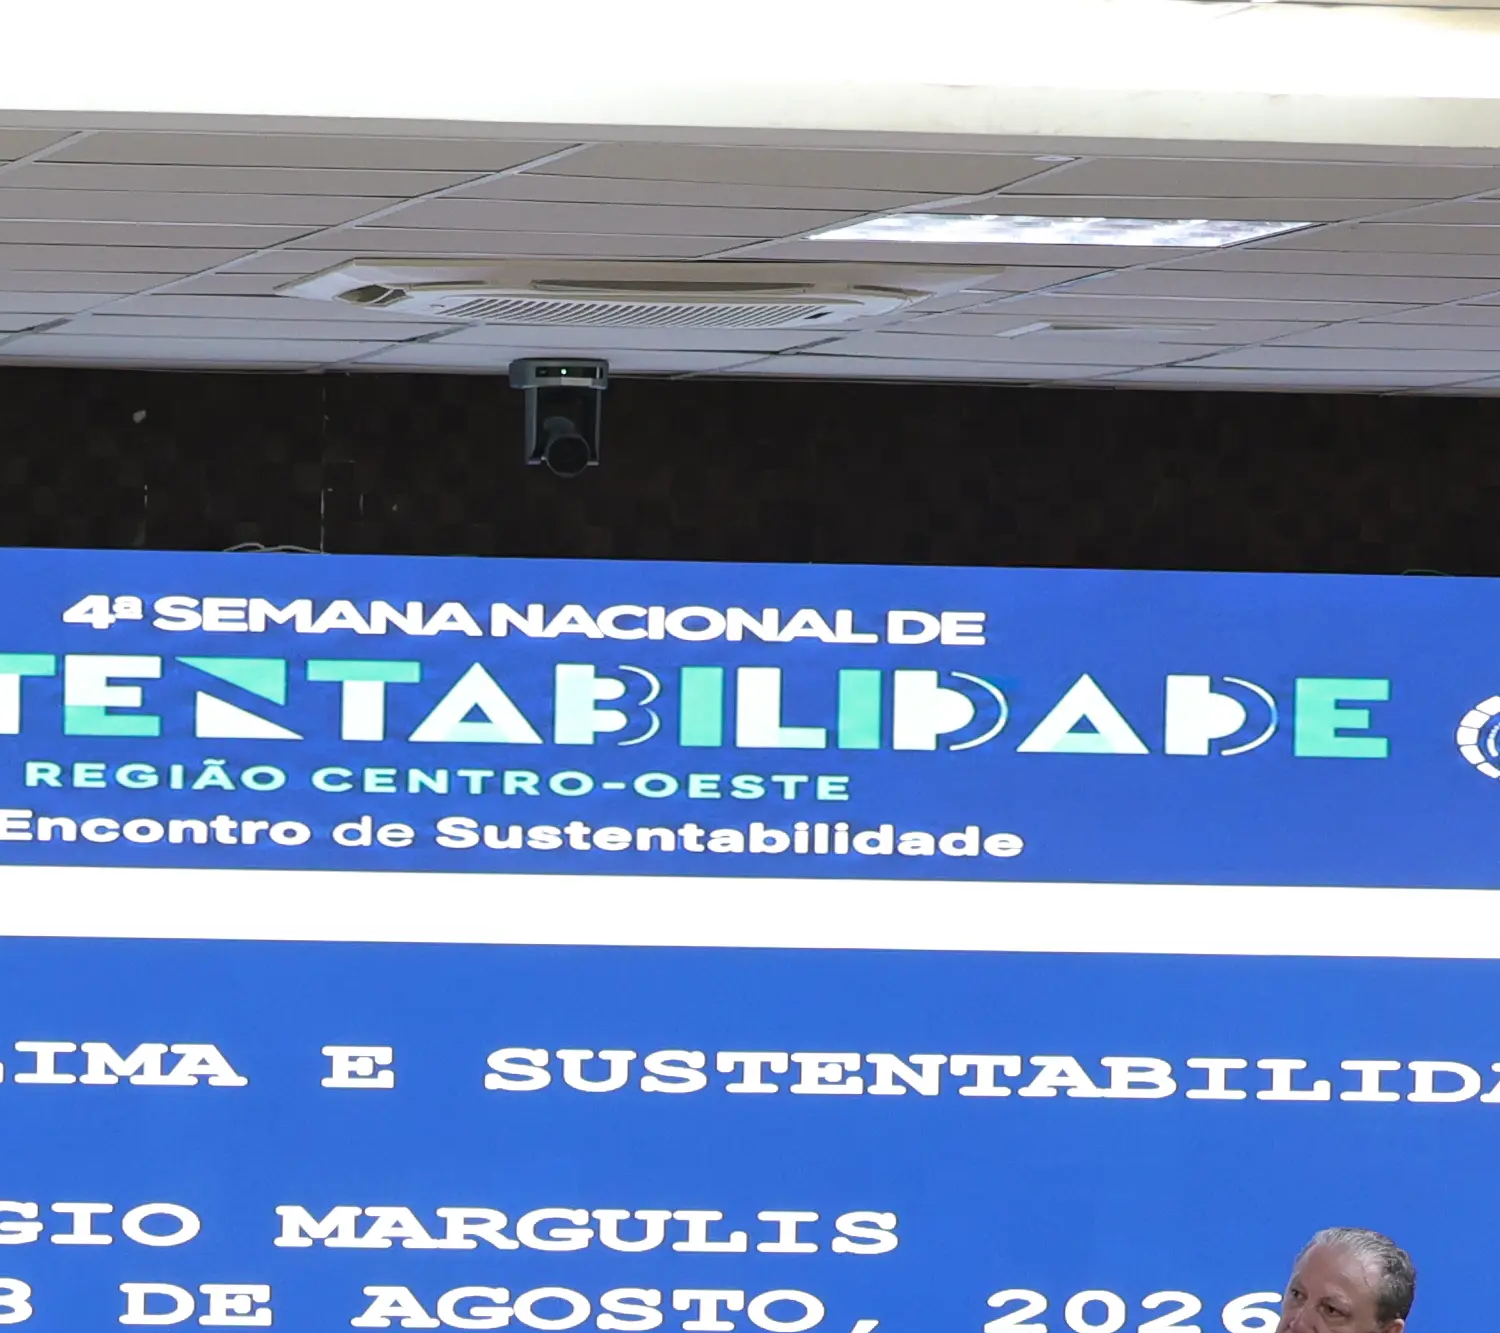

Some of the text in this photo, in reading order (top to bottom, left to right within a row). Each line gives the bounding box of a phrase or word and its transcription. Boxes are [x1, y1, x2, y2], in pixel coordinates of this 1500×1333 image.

[63, 595, 986, 645] 4ª SEMANA NACIONAL DE
[26, 759, 849, 800] REGIÃO CENTRO-OESTE
[333, 816, 414, 848] de
[436, 817, 1023, 858] Sustentabilidade
[321, 1046, 394, 1089] E
[274, 1206, 898, 1254] MARGULIS
[119, 1283, 272, 1327] DE
